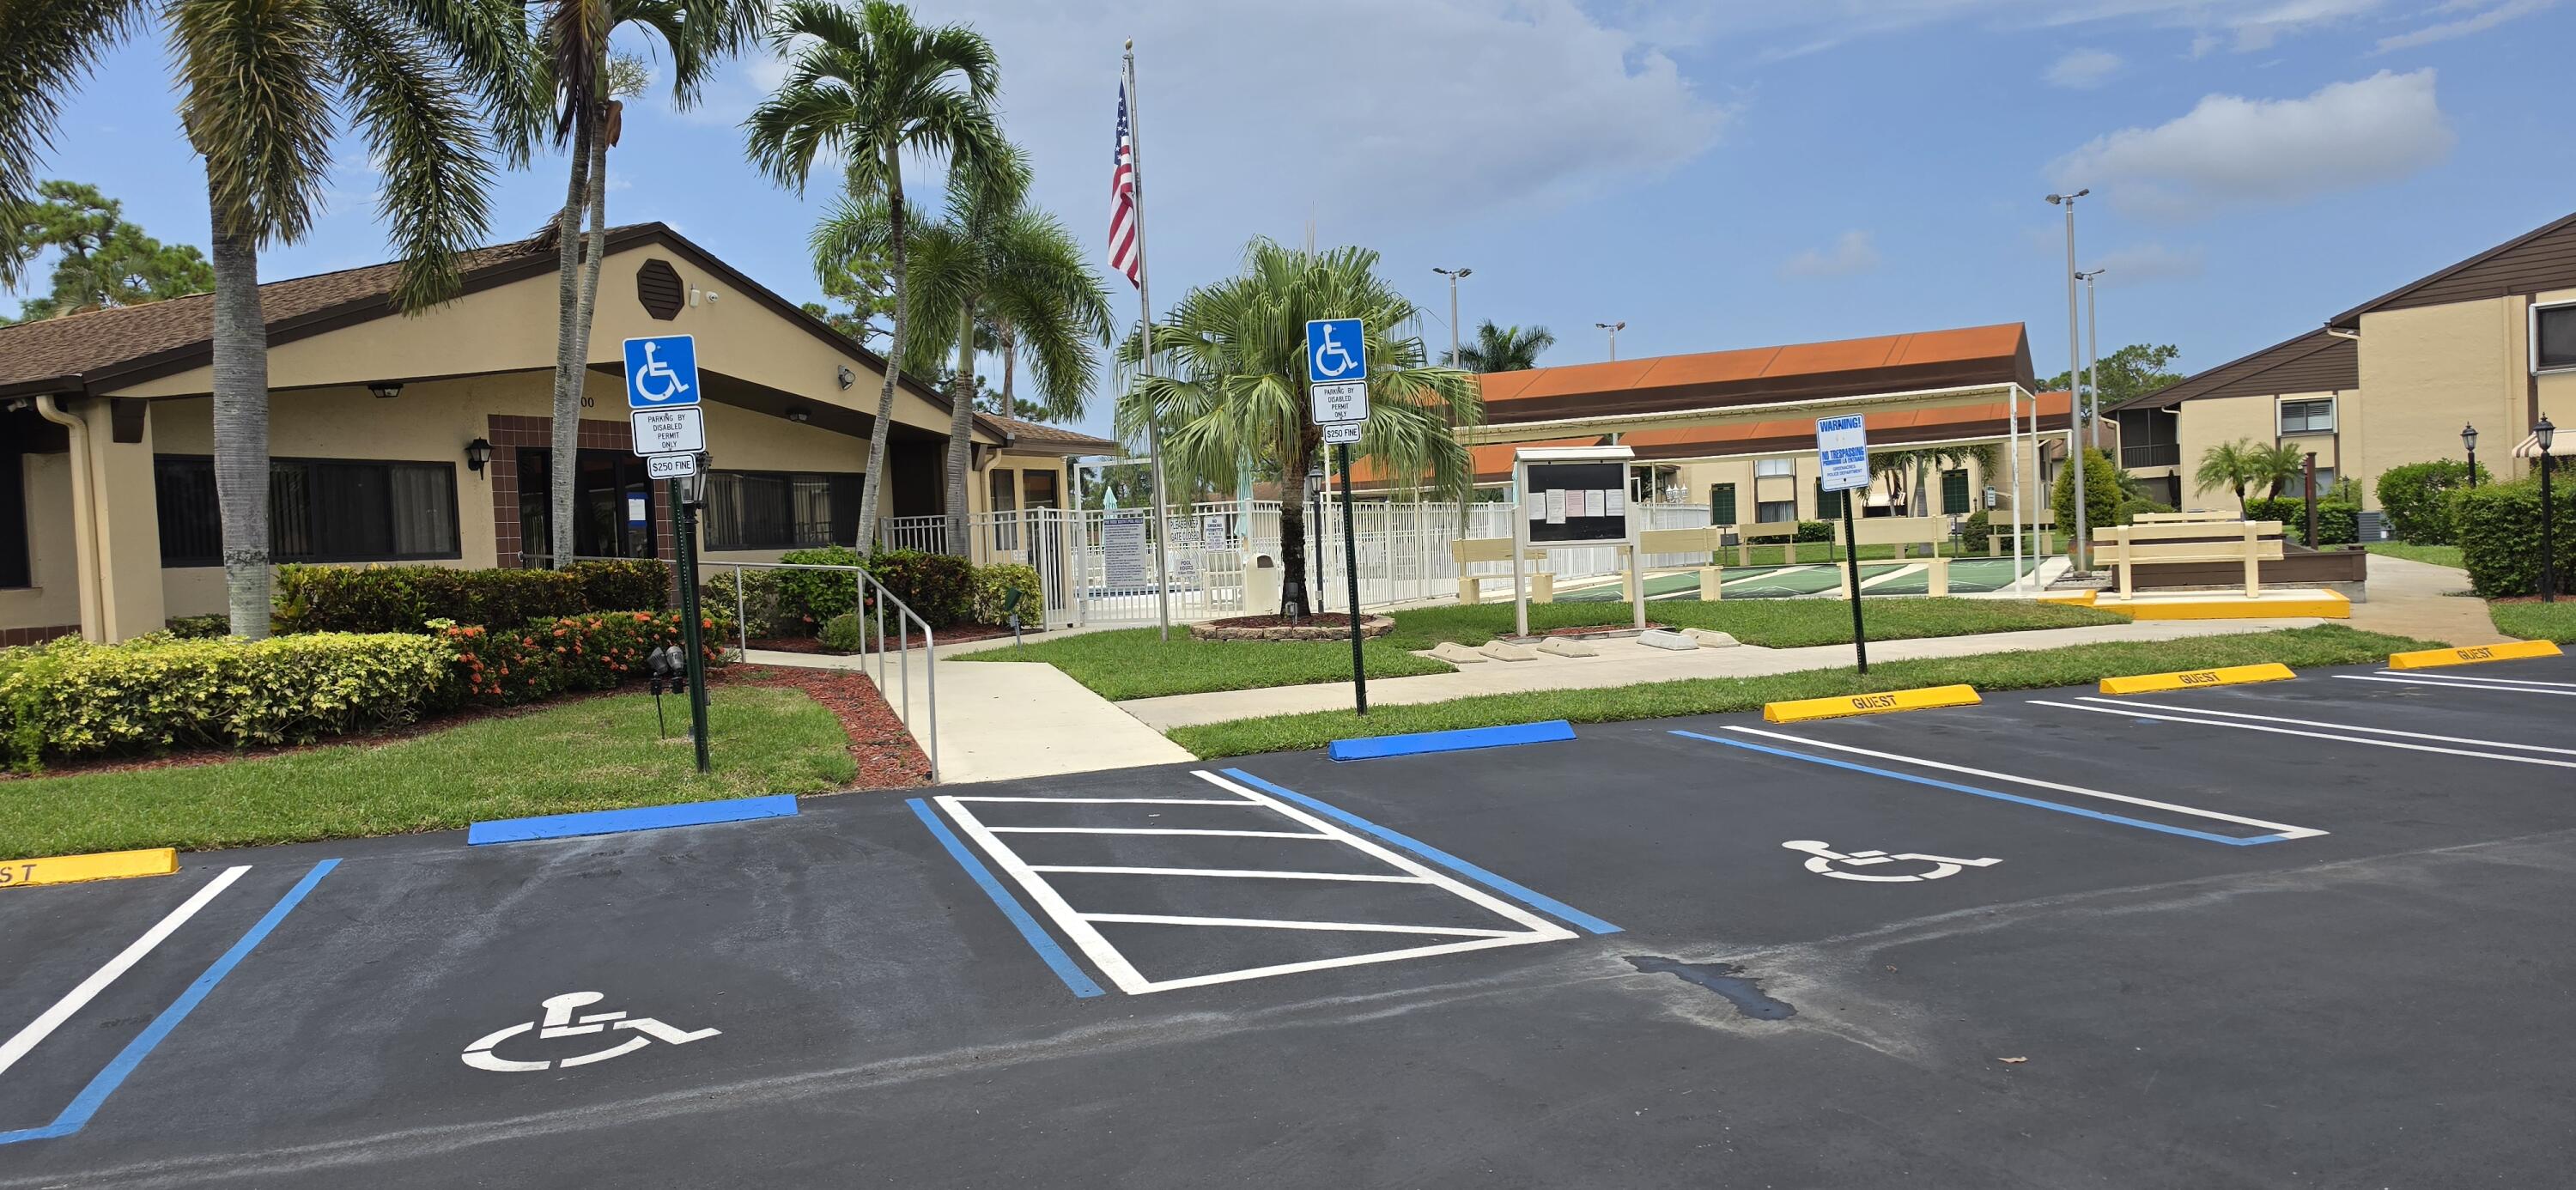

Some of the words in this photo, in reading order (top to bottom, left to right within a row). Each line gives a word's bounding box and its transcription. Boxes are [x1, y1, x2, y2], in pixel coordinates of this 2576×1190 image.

[647, 414, 673, 422] PARKING
[653, 422, 683, 431] DISABLED
[1820, 417, 1861, 432] WARNING!
[658, 431, 680, 440] PERMIT
[1821, 451, 1829, 460] NO
[1830, 446, 1864, 459] TRESPASSING
[653, 462, 673, 472] $250
[675, 460, 691, 470] FINE
[1170, 519, 1188, 530] PLEASE
[1171, 532, 1182, 542] GATE
[1182, 531, 1200, 541] CLOSED
[2457, 647, 2494, 659] GUEST
[2178, 671, 2221, 684] GUEST
[1852, 695, 1897, 708] GUEST
